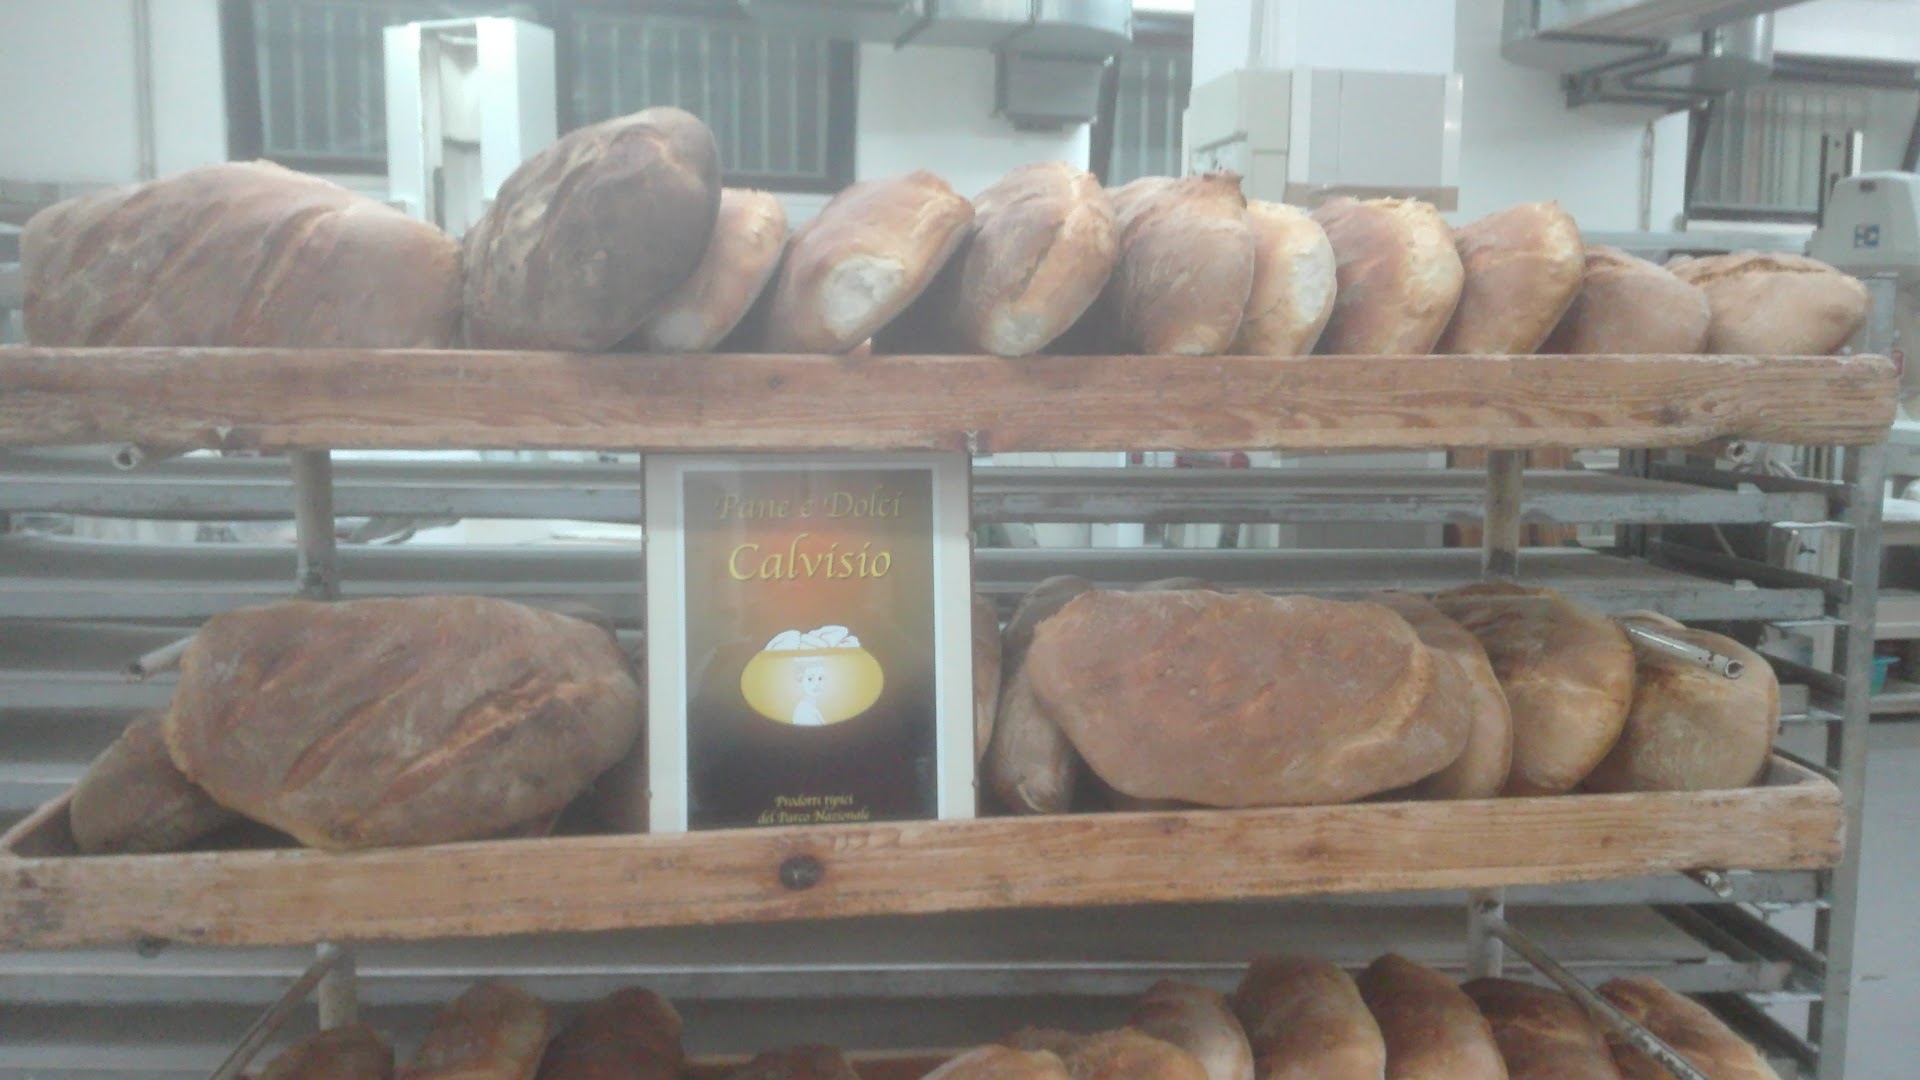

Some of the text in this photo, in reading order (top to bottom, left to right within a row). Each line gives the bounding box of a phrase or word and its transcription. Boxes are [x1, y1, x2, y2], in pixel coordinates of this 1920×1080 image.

[715, 485, 904, 519] Pane e Dolci
[728, 533, 892, 581] Calvisio
